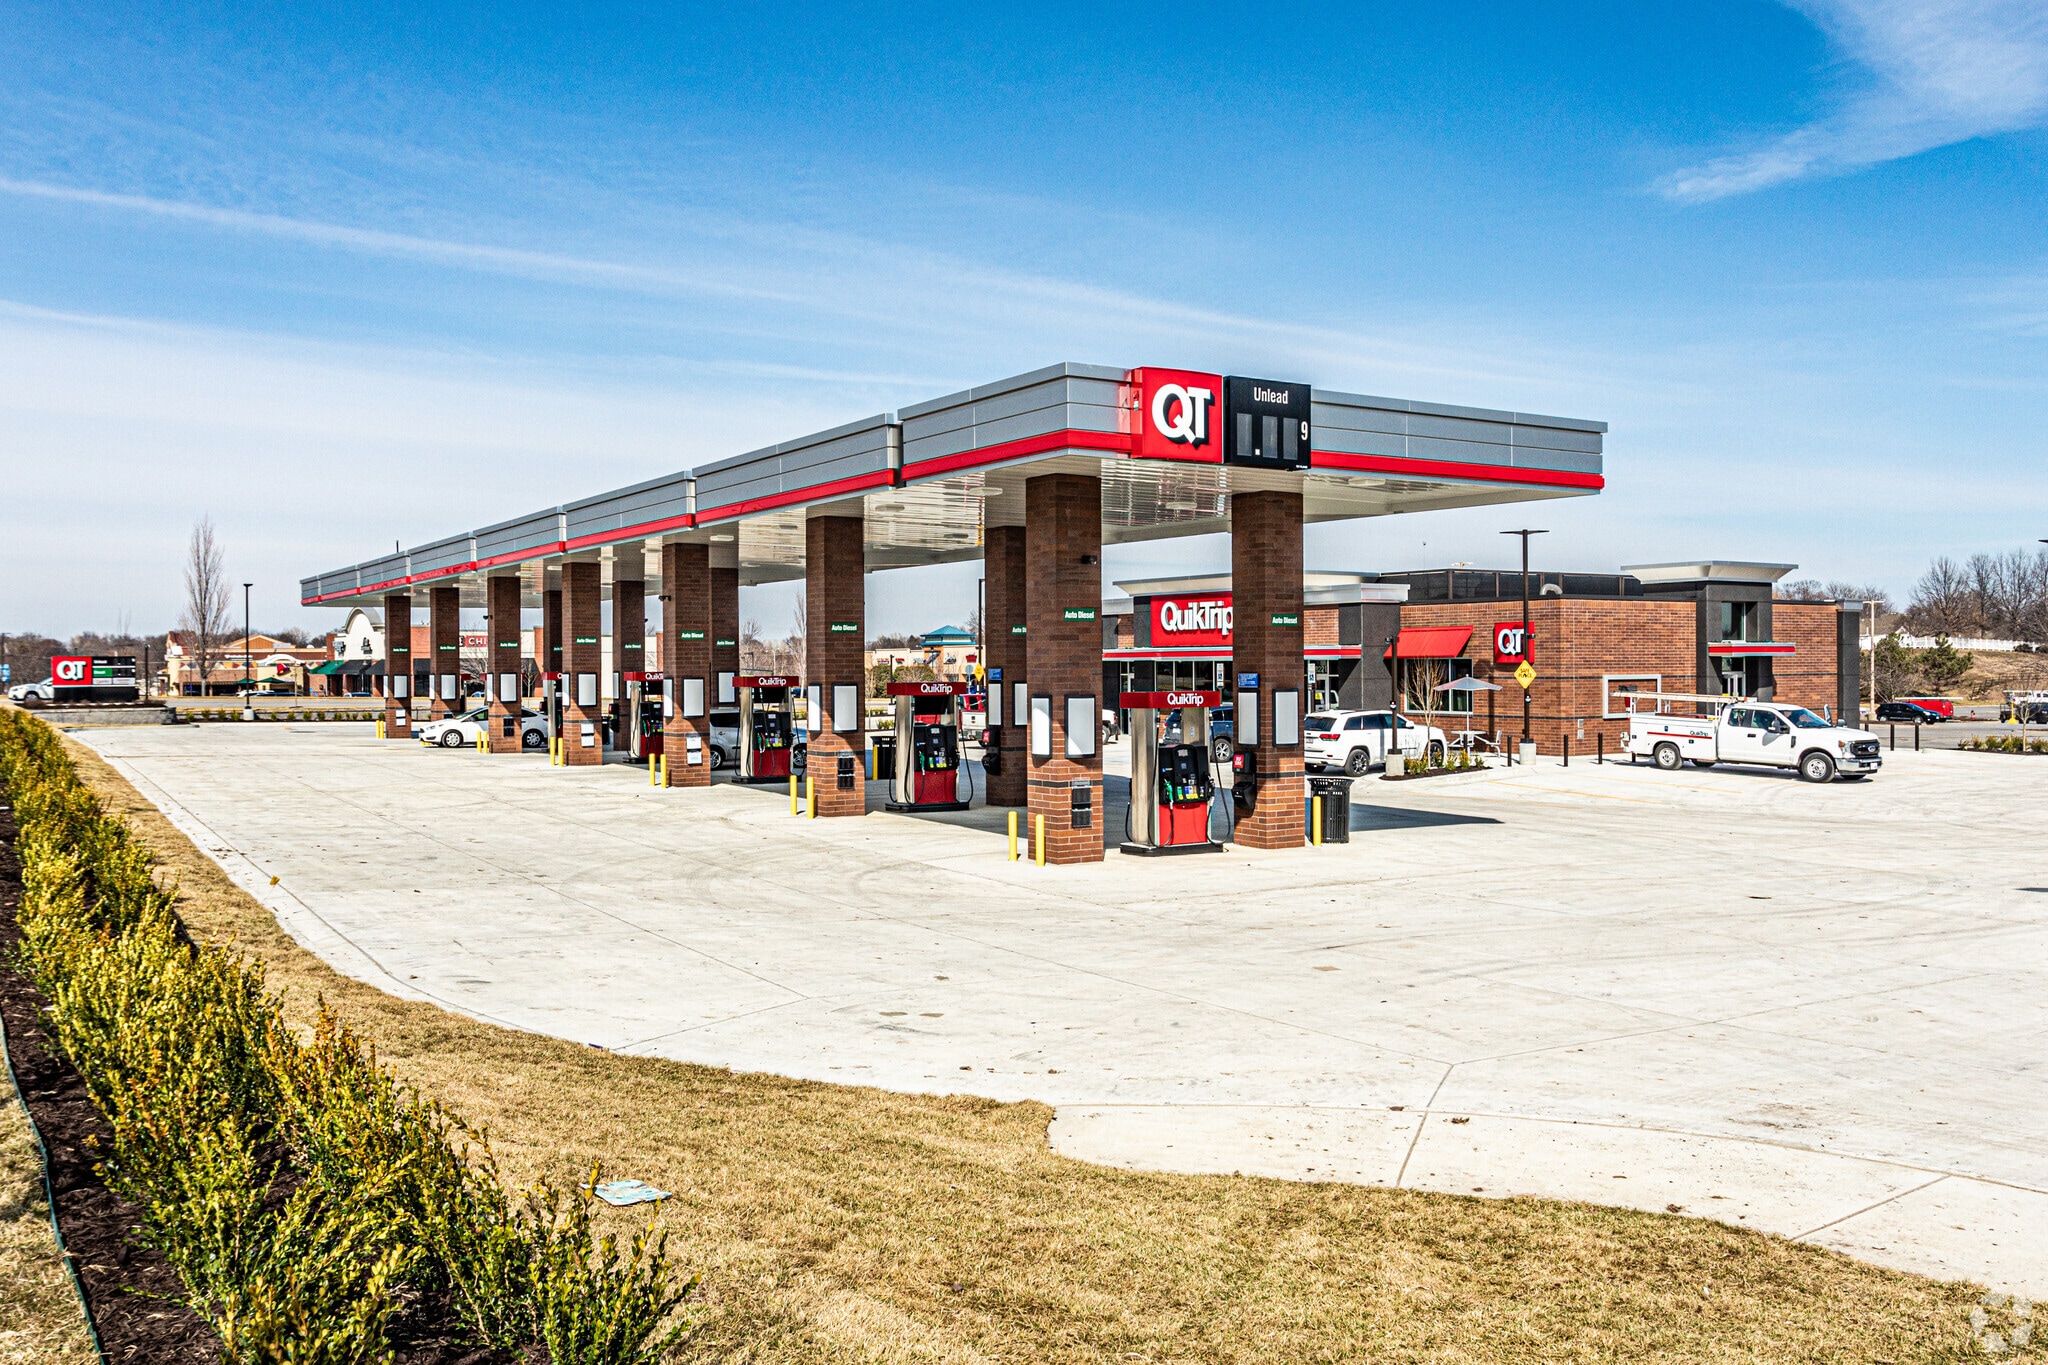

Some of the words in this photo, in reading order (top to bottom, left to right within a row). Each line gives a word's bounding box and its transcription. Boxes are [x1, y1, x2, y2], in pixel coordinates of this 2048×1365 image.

[1254, 387, 1288, 405] Unlead
[1152, 384, 1212, 445] QT
[1301, 421, 1309, 440] 9
[1064, 610, 1077, 619] Auto
[1078, 610, 1095, 619] Diesel
[1160, 601, 1233, 636] QuikTrip
[1272, 616, 1283, 624] Auto
[1284, 616, 1298, 624] Diesel
[1498, 628, 1525, 655] QT
[56, 660, 87, 680] QT
[758, 677, 787, 687] QuikTrip
[921, 684, 953, 694] QuikTrip
[1167, 693, 1204, 706] QuikTrip
